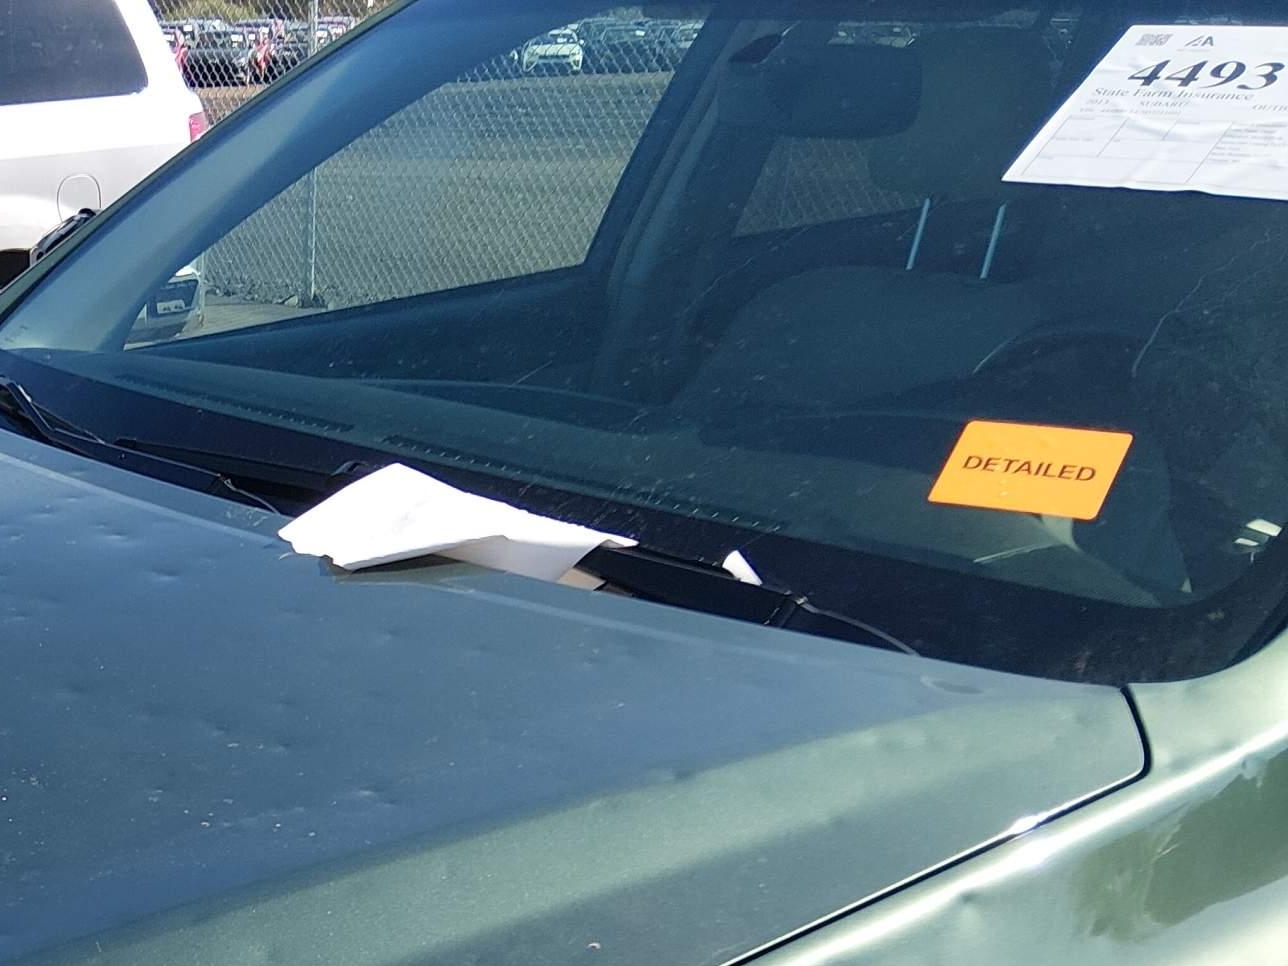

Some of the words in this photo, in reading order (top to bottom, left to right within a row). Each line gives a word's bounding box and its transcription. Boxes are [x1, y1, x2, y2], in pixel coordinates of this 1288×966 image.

[1127, 59, 1286, 90] 4493
[1091, 87, 1130, 97] State
[1132, 88, 1173, 98] Farm
[1174, 89, 1256, 100] Insurance
[962, 455, 1097, 482] DETAILED
